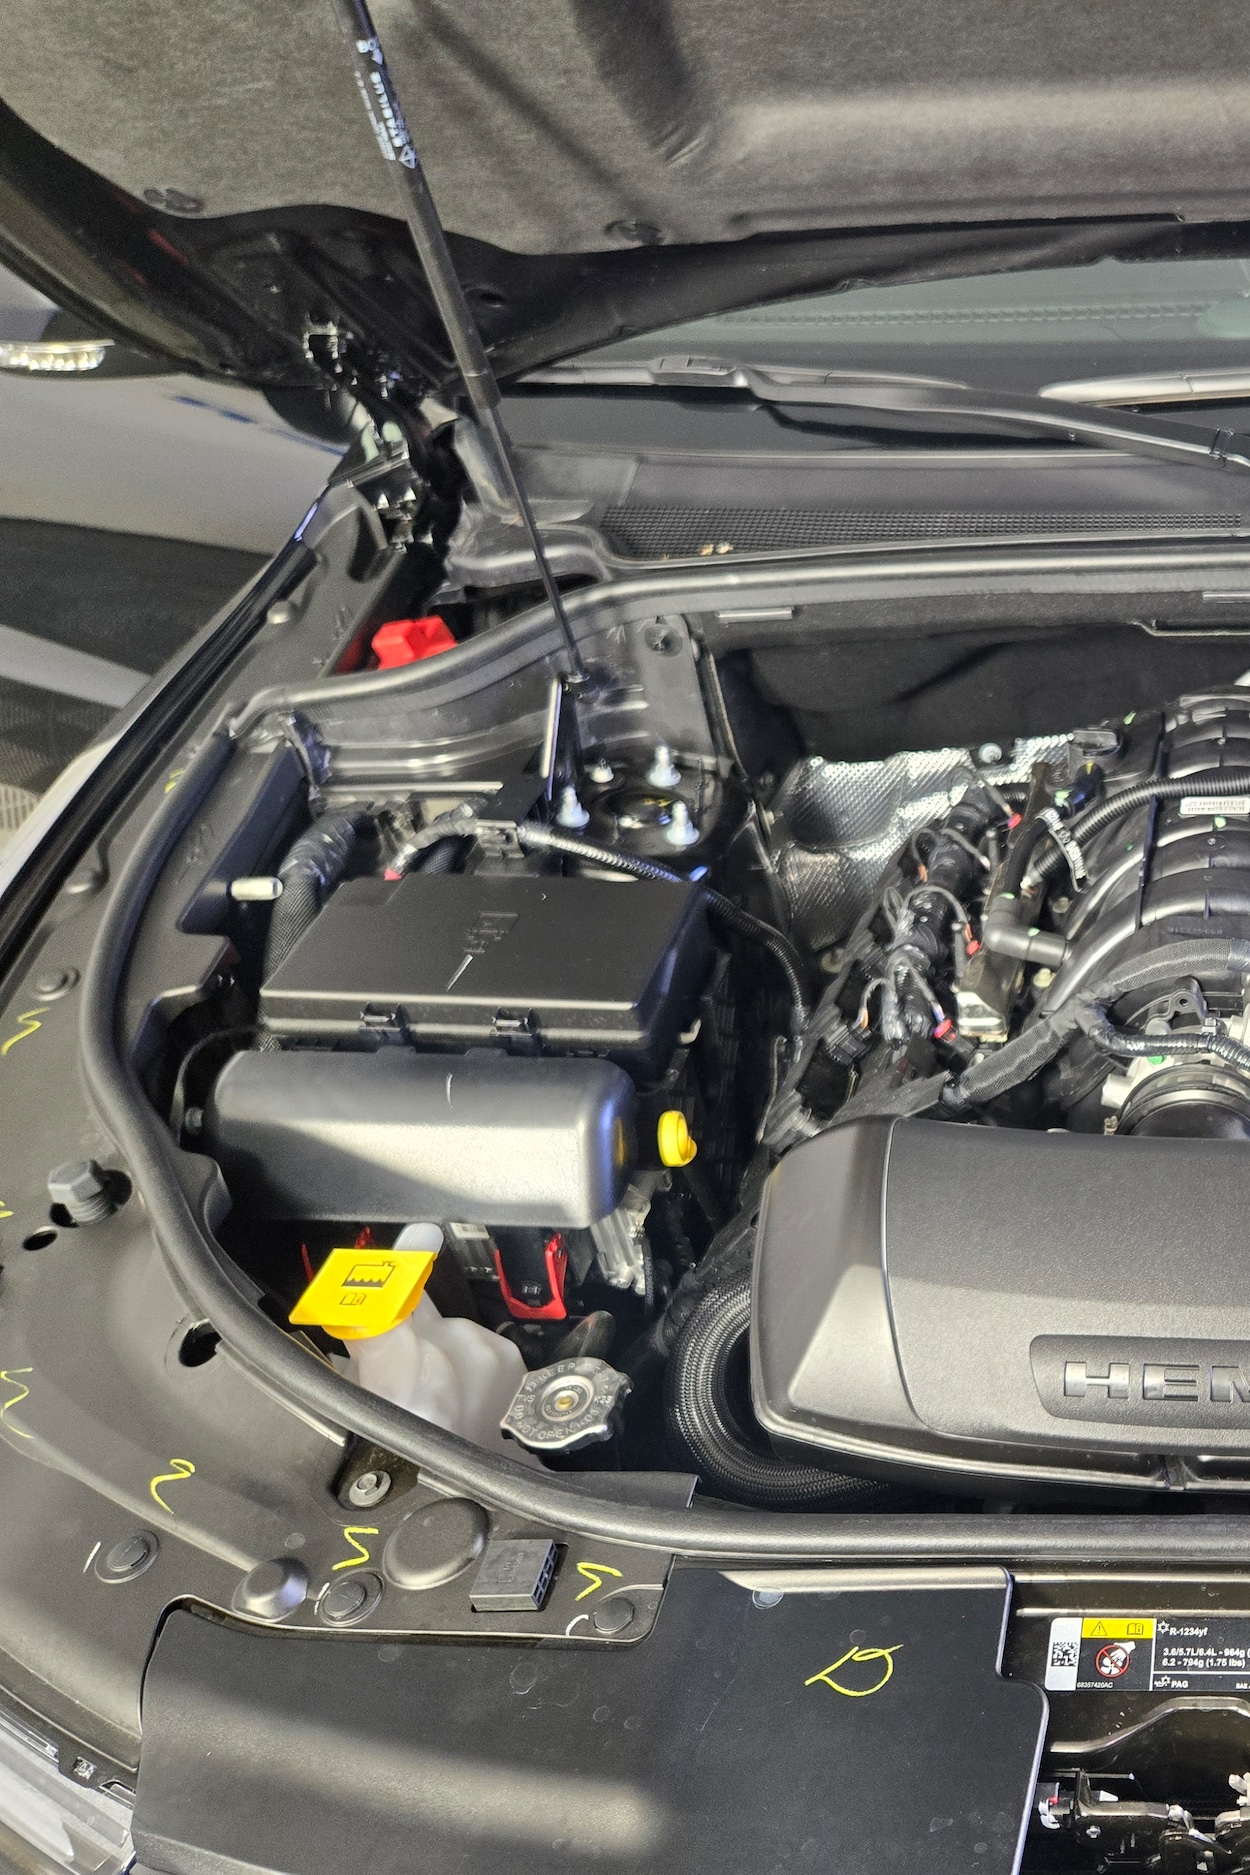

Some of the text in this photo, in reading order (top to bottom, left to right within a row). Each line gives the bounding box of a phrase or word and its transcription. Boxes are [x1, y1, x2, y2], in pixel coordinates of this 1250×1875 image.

[1169, 1626, 1209, 1638] R-1234yf
[1163, 1647, 1218, 1656] 3.6/5.7L/6.4L
[1161, 1657, 1176, 1667] 6.2
[1182, 1657, 1205, 1669] 794g
[1205, 1657, 1228, 1668] (1.75
[1228, 1658, 1246, 1669] lbs)
[1170, 1680, 1189, 1689] PAG
